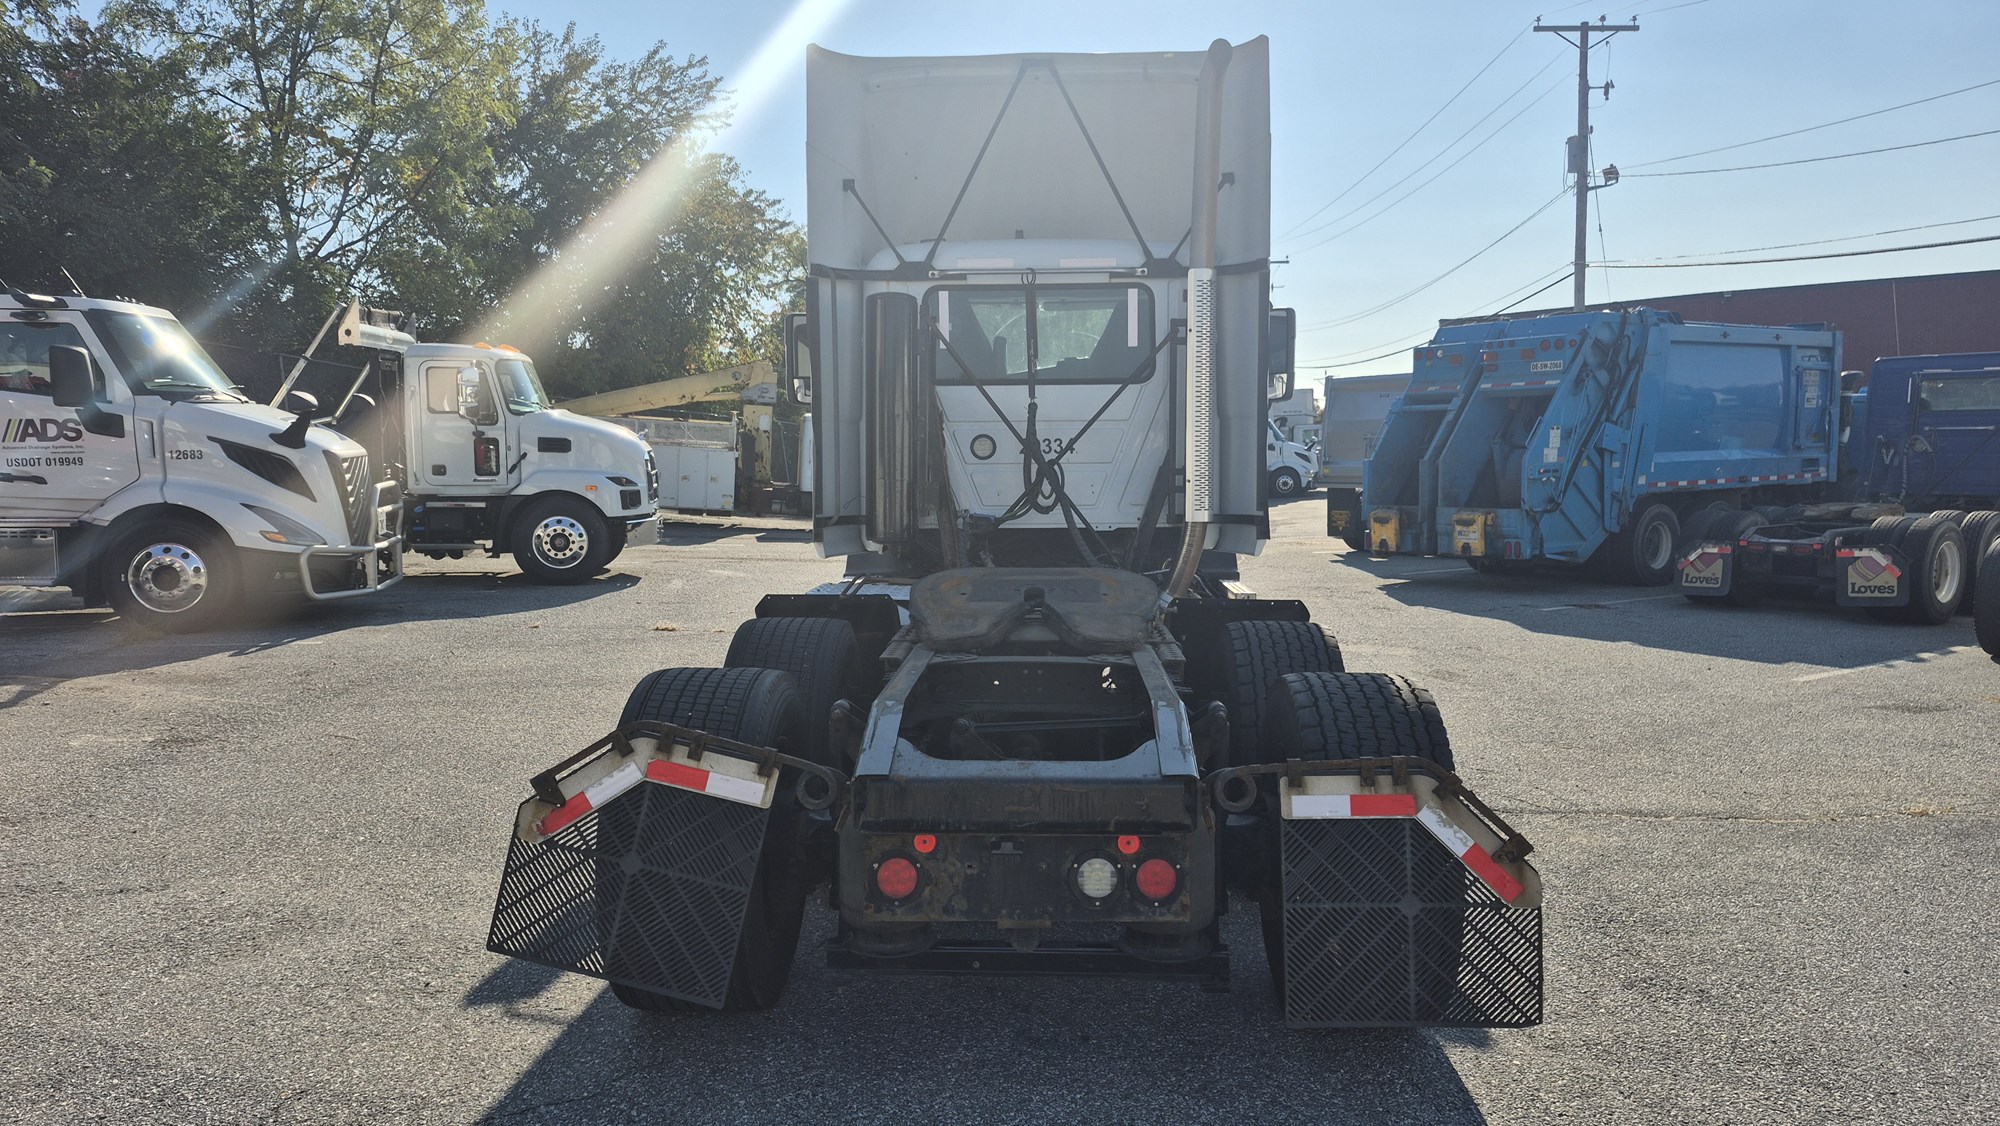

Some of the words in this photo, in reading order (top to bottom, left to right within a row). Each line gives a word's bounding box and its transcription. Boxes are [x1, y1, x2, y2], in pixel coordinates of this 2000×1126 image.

[18, 418, 83, 442] ADS
[168, 449, 203, 460] 12683
[6, 457, 42, 467] USDOT
[45, 457, 84, 466] 019949
